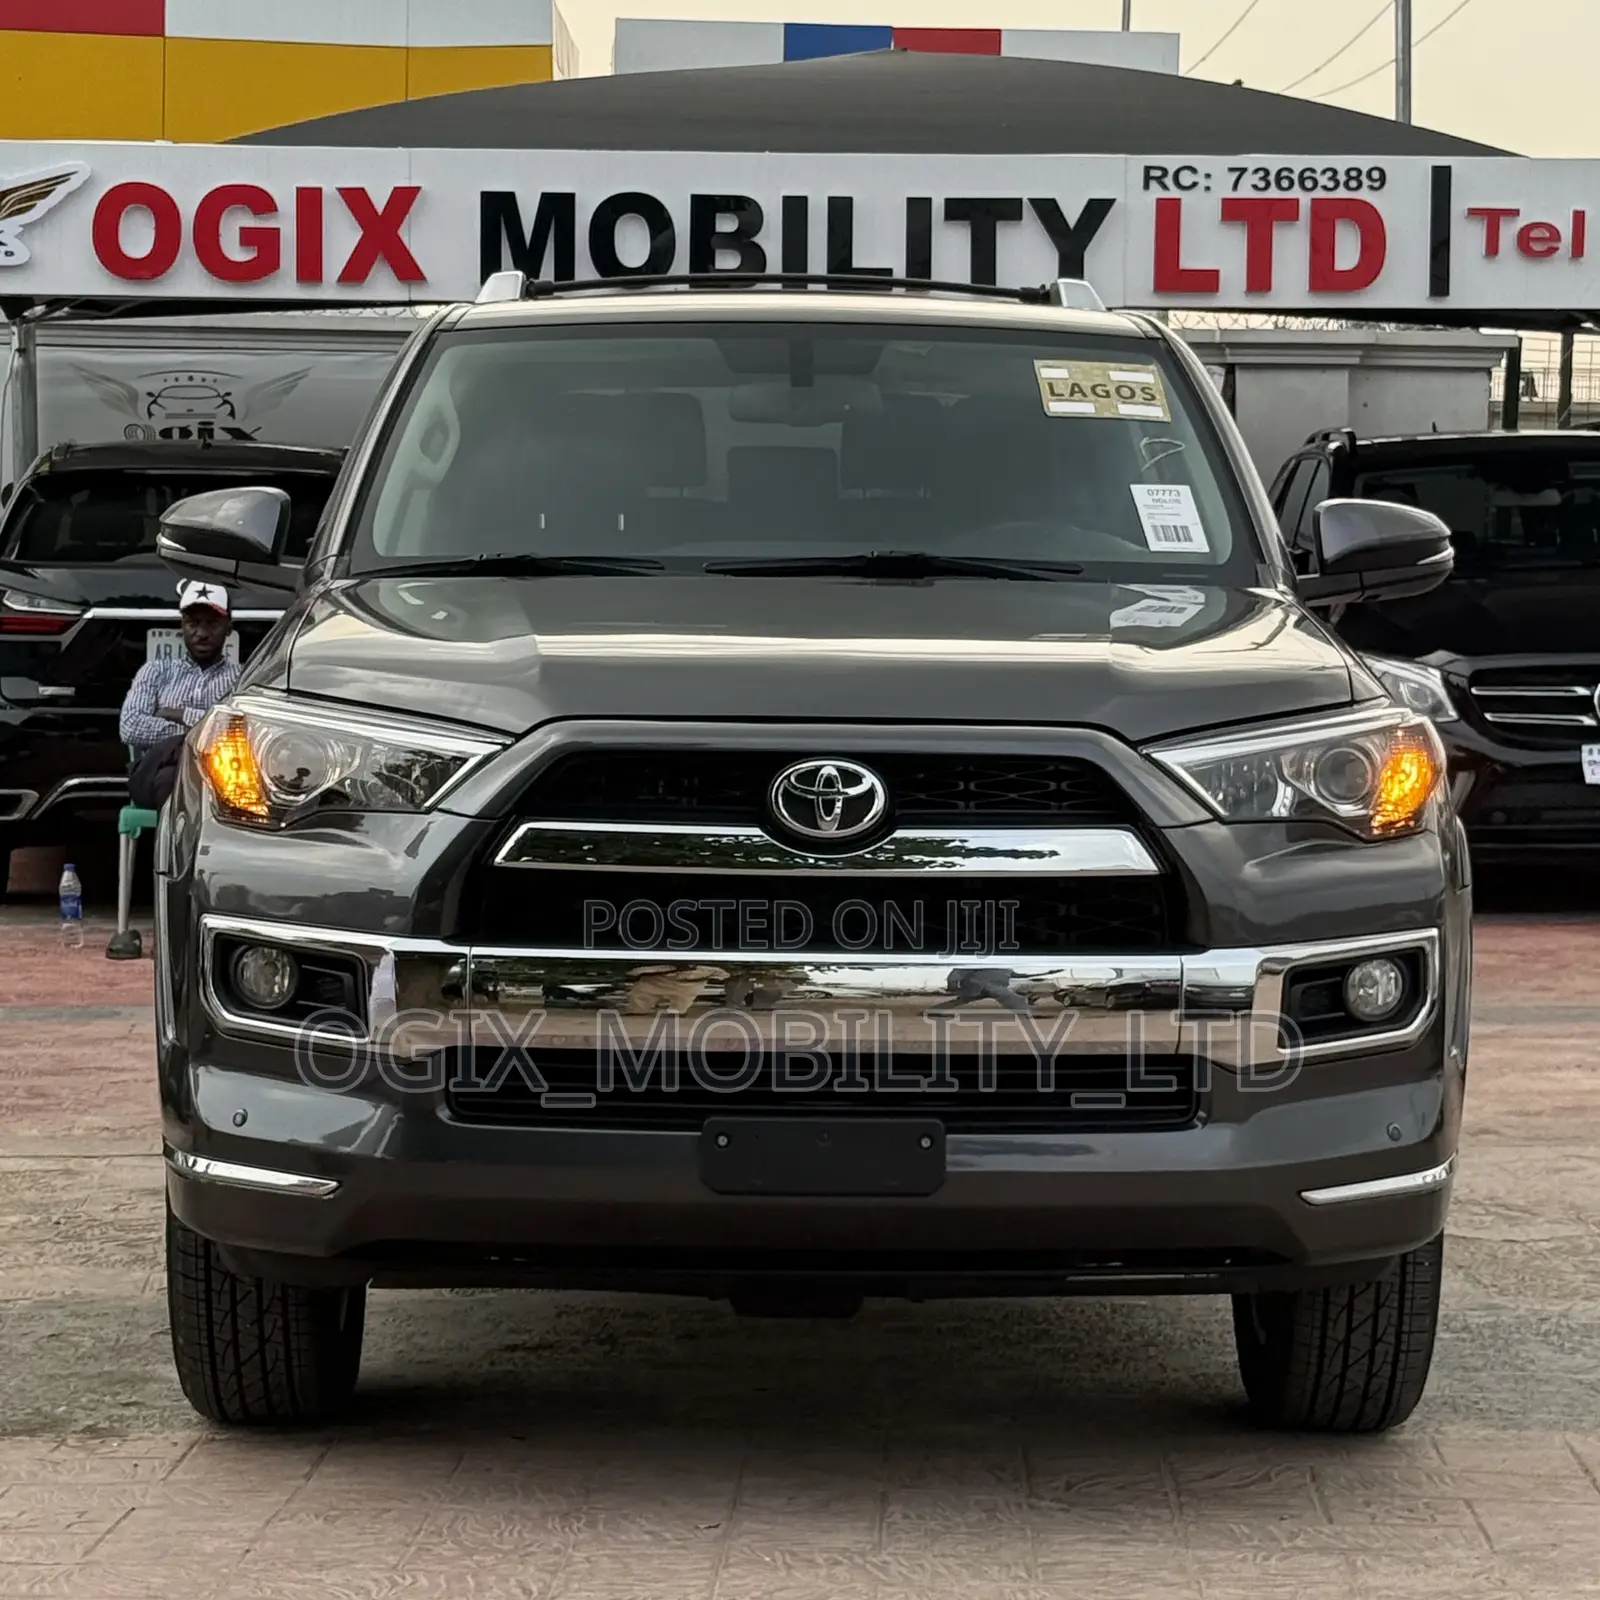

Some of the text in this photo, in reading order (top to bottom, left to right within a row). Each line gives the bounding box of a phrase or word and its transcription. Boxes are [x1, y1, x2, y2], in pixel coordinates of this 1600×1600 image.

[1142, 165, 1388, 193] RC: 7366389
[92, 181, 1387, 293] OGIX MOBILITY LTD
[1465, 207, 1586, 260] Tel
[1046, 382, 1157, 402] LAGOS
